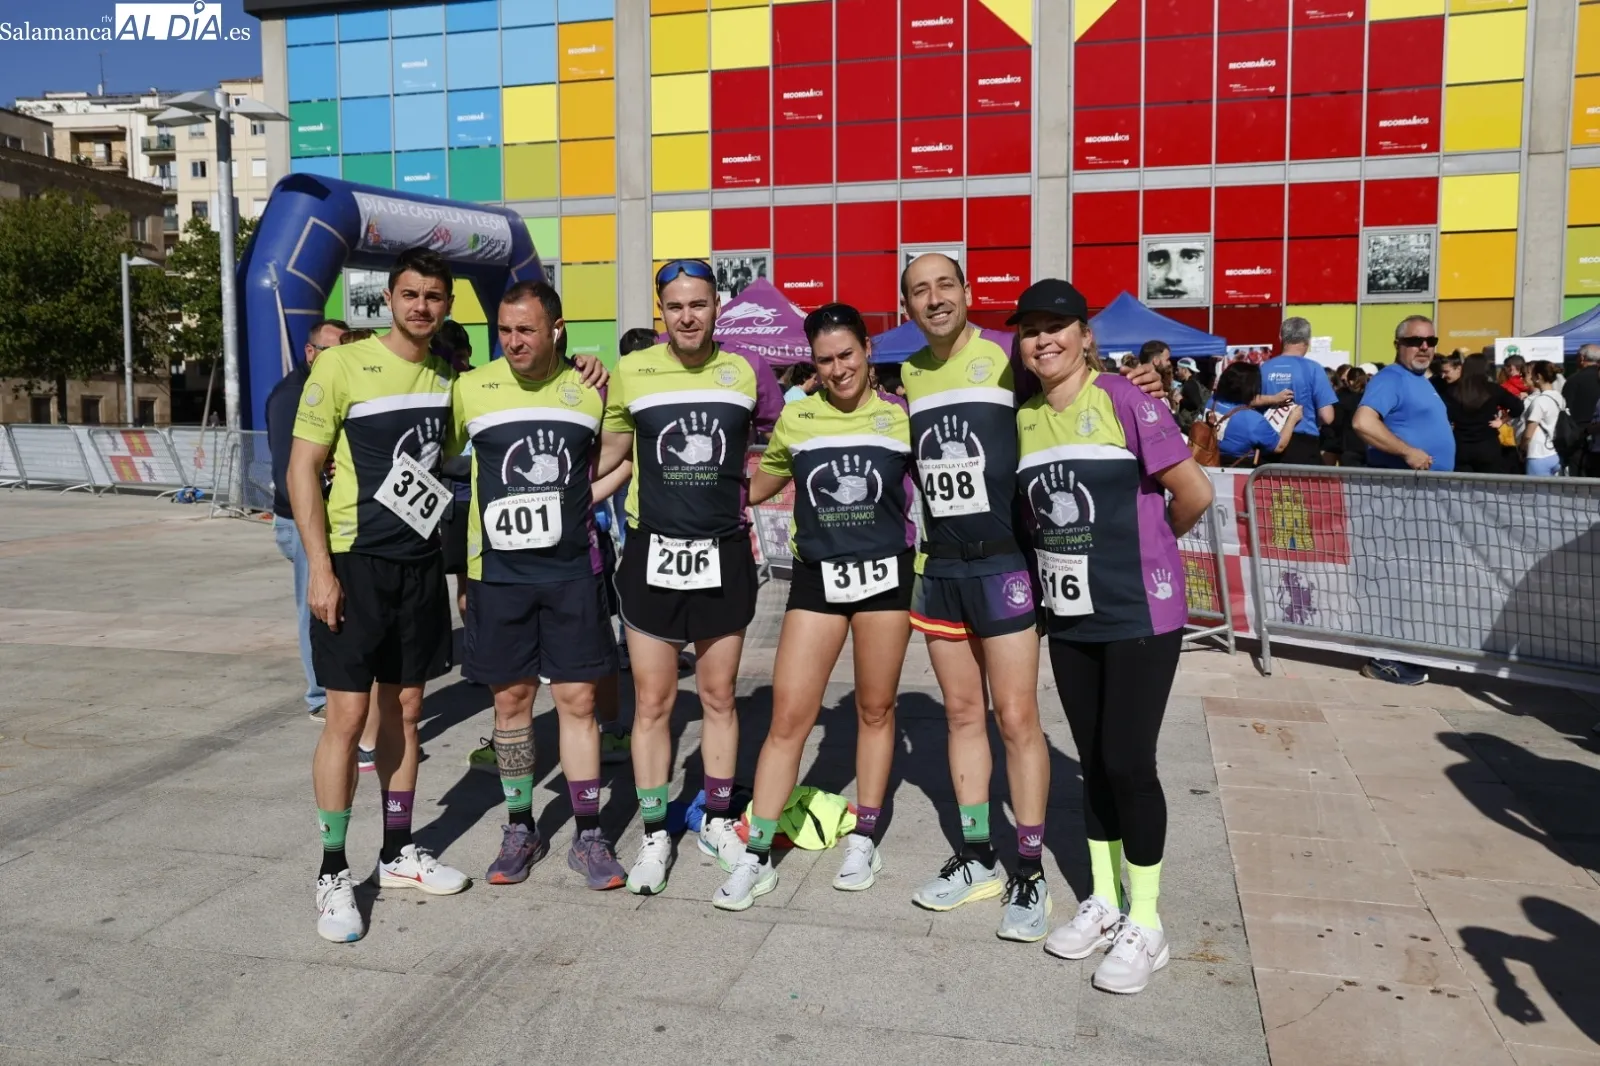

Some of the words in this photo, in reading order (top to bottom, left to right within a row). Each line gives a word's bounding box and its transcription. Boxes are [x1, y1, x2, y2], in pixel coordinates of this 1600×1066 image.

[360, 197, 388, 215] DÍA
[388, 202, 407, 217] DE
[408, 205, 466, 225] CASTILLA
[465, 212, 474, 225] Y
[477, 214, 507, 230] LEÓN
[663, 472, 693, 480] ROBERTO
[694, 472, 718, 480] RAMOS
[925, 471, 975, 501] 498
[393, 470, 439, 520] 379
[818, 506, 835, 514] CLUB
[836, 505, 875, 513] DEPORTIVO
[495, 505, 550, 535] 401
[818, 513, 849, 522] ROBERTO
[851, 512, 875, 521] RAMOS
[1055, 526, 1091, 535] DEPORTIVO
[1043, 535, 1065, 545] ROBERTO
[1066, 533, 1092, 545] RAMOS
[657, 548, 709, 577] 206
[833, 560, 889, 589] 315
